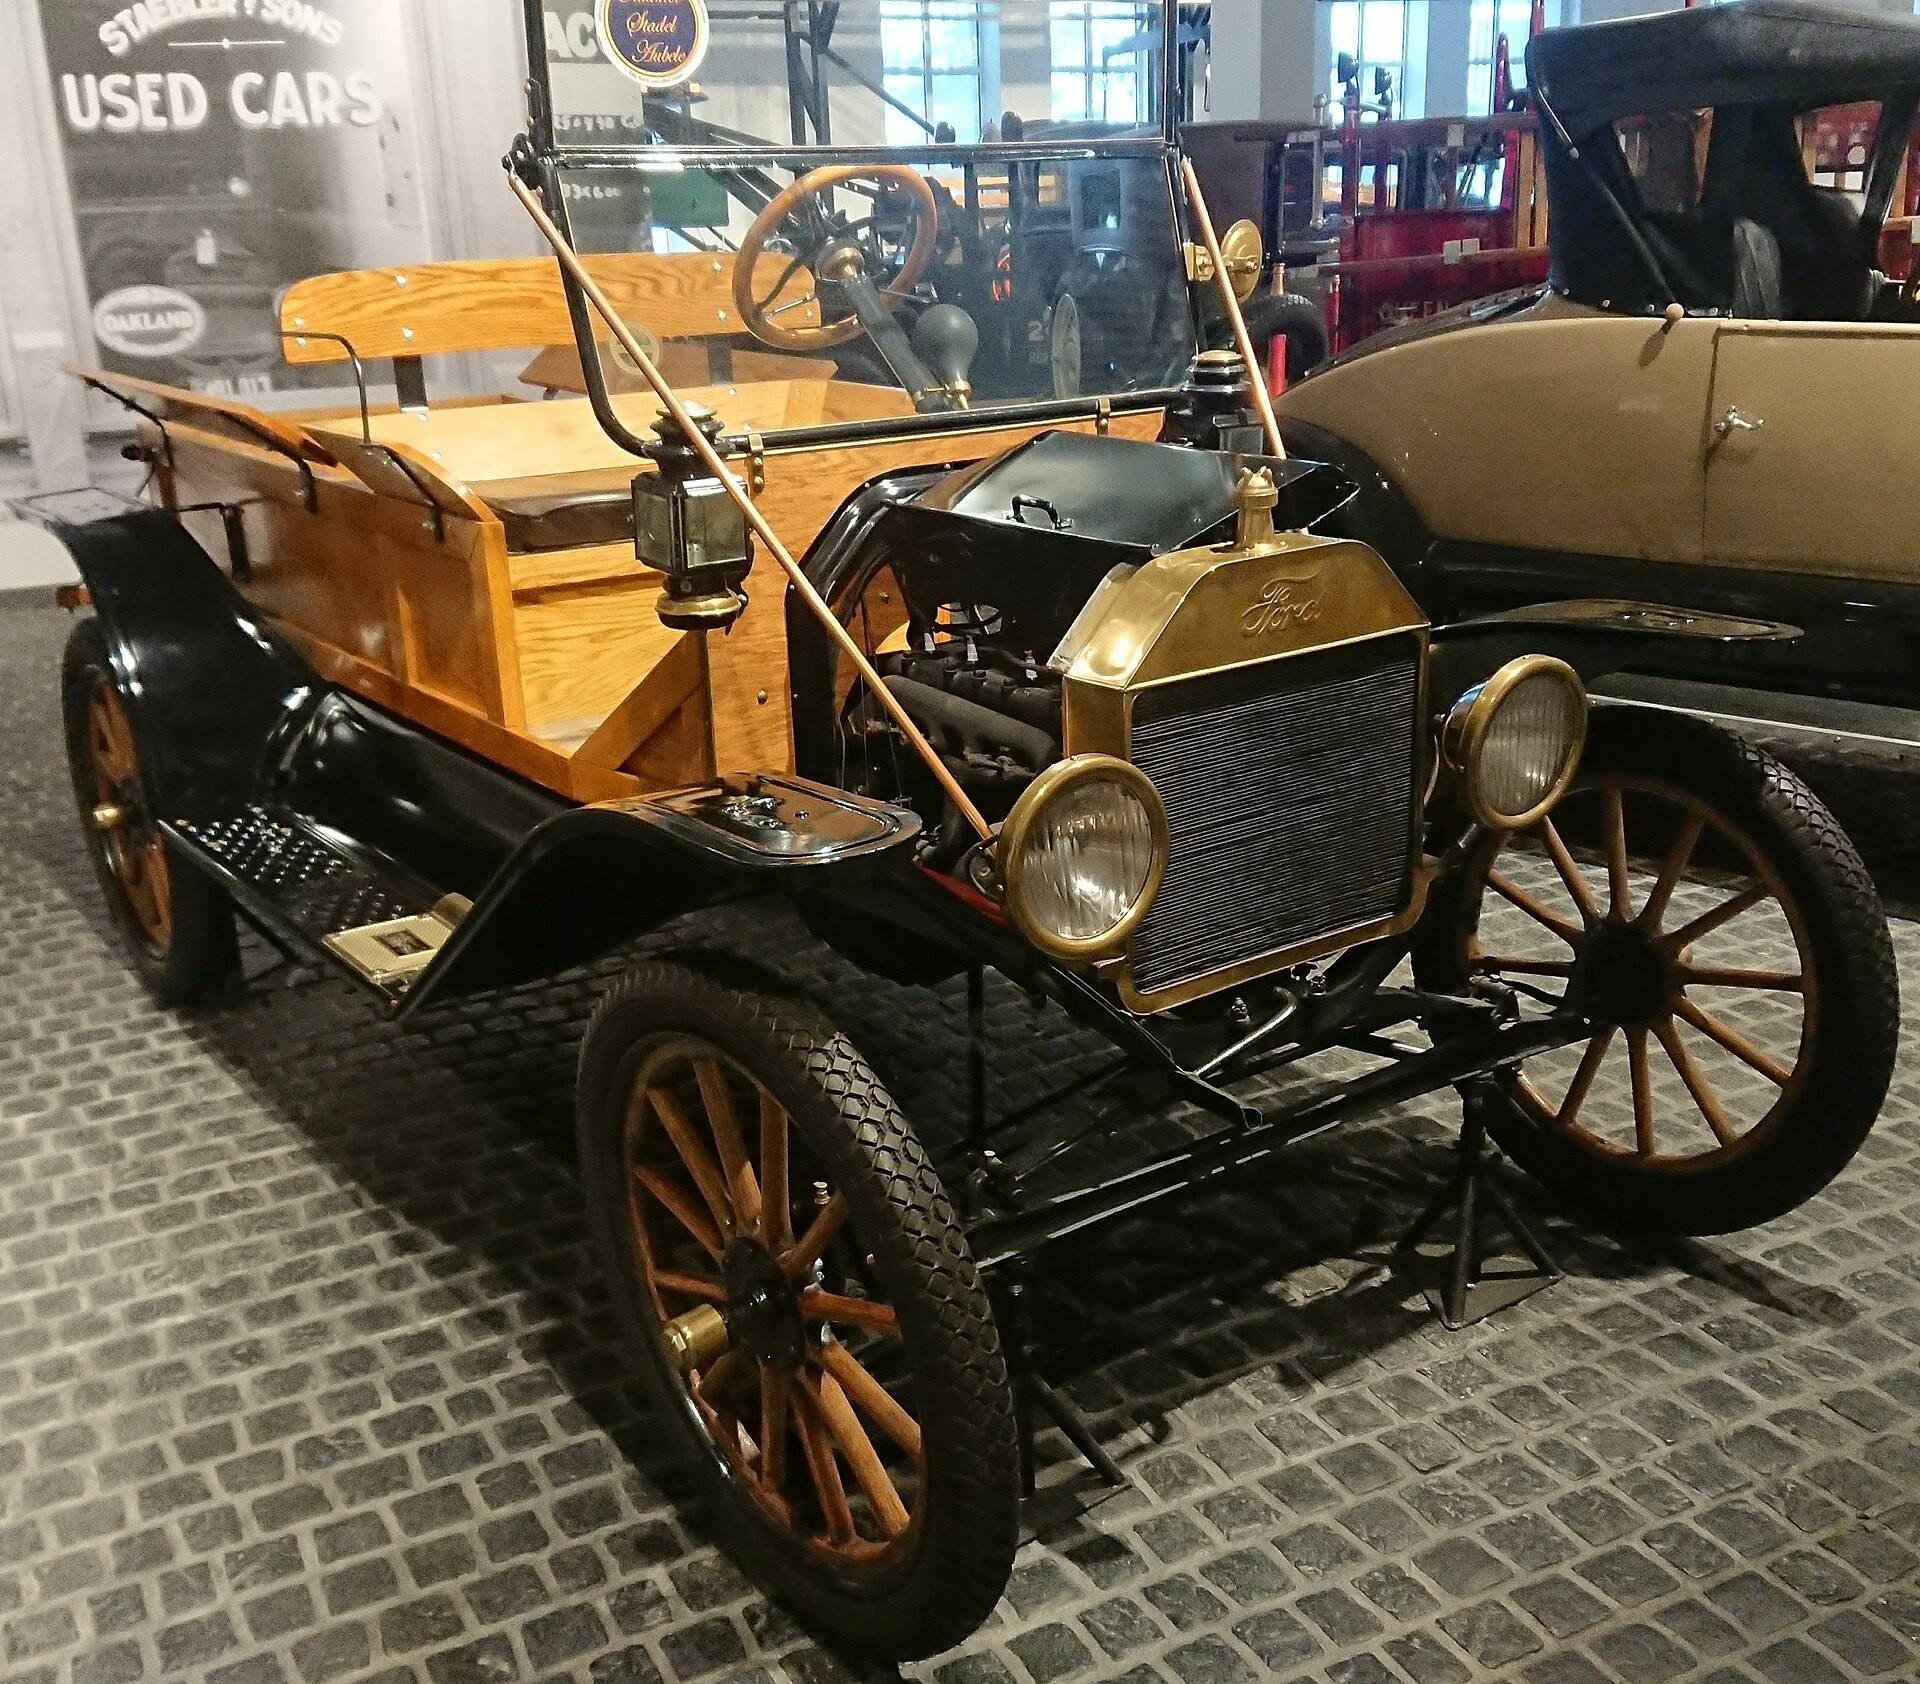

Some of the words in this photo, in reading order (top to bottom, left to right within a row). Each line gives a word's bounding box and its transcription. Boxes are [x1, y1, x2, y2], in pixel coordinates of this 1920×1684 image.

[262, 0, 346, 46] SONS
[626, 10, 678, 37] Stadel
[62, 73, 208, 129] USED
[231, 72, 382, 128] CARS
[103, 310, 194, 332] OAKLAND
[1240, 561, 1325, 637] Ford
